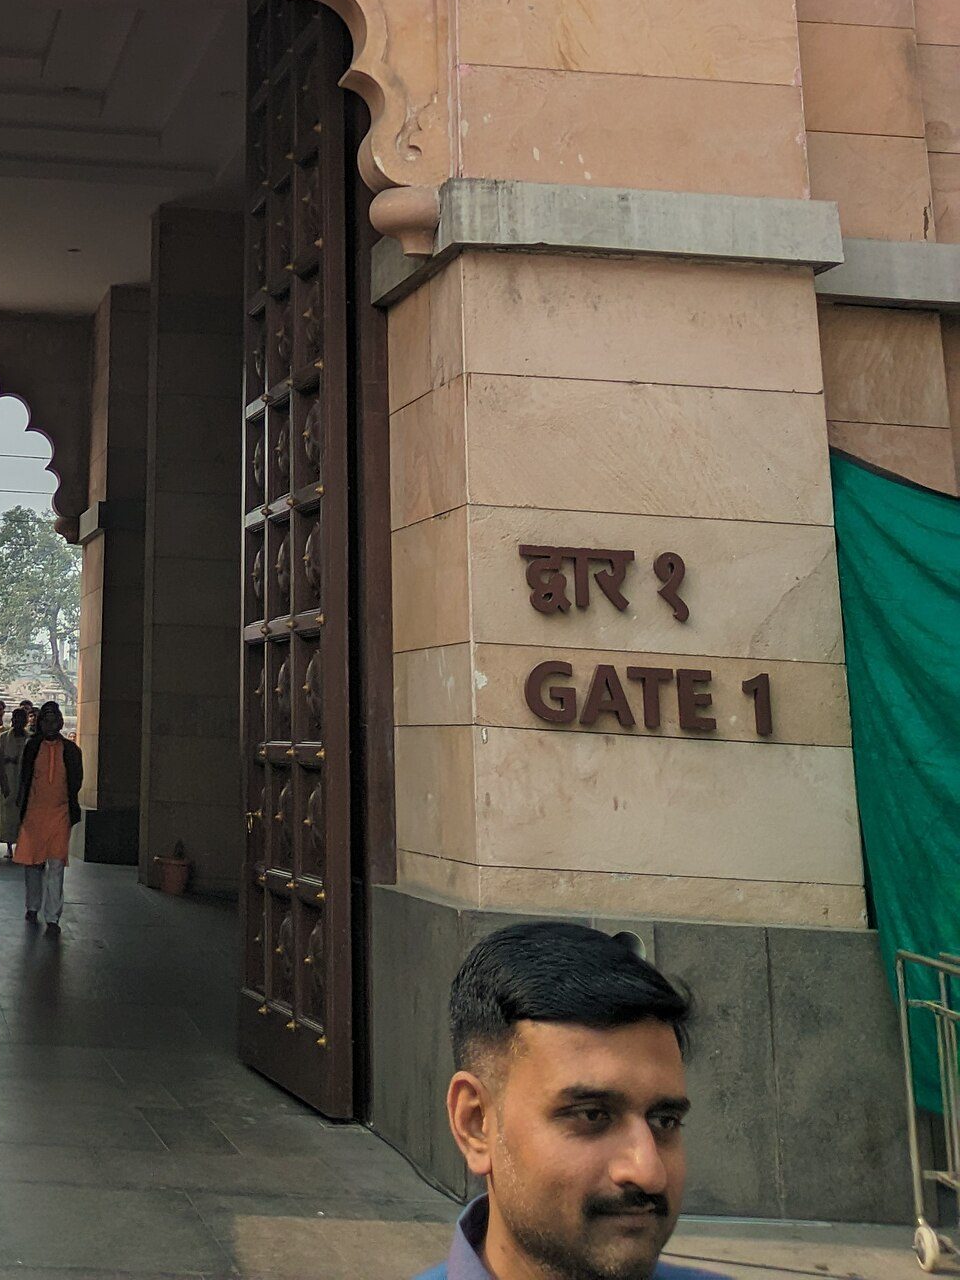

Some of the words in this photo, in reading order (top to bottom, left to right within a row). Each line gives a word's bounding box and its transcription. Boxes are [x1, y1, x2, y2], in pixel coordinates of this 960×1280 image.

[518, 544, 635, 614] द्वार
[653, 551, 689, 622] १
[524, 660, 717, 730] GATE
[742, 673, 773, 737] 1
